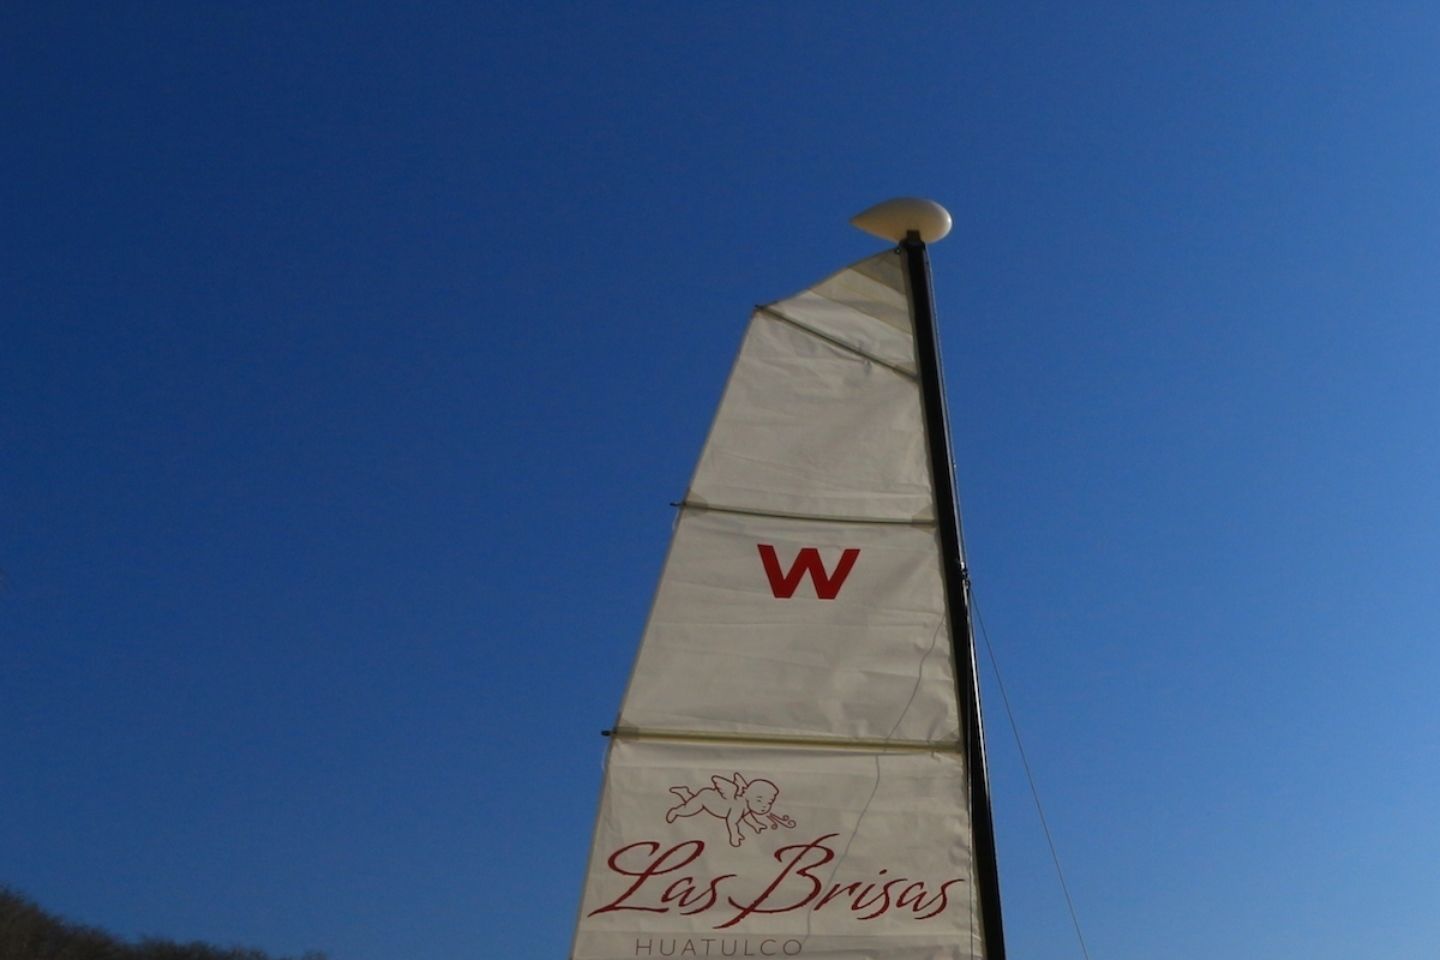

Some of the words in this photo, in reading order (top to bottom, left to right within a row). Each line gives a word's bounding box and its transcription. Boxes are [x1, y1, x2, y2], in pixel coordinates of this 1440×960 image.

[587, 839, 737, 918] Las
[713, 833, 964, 929] Brisas
[635, 938, 803, 957] HUATULCO
